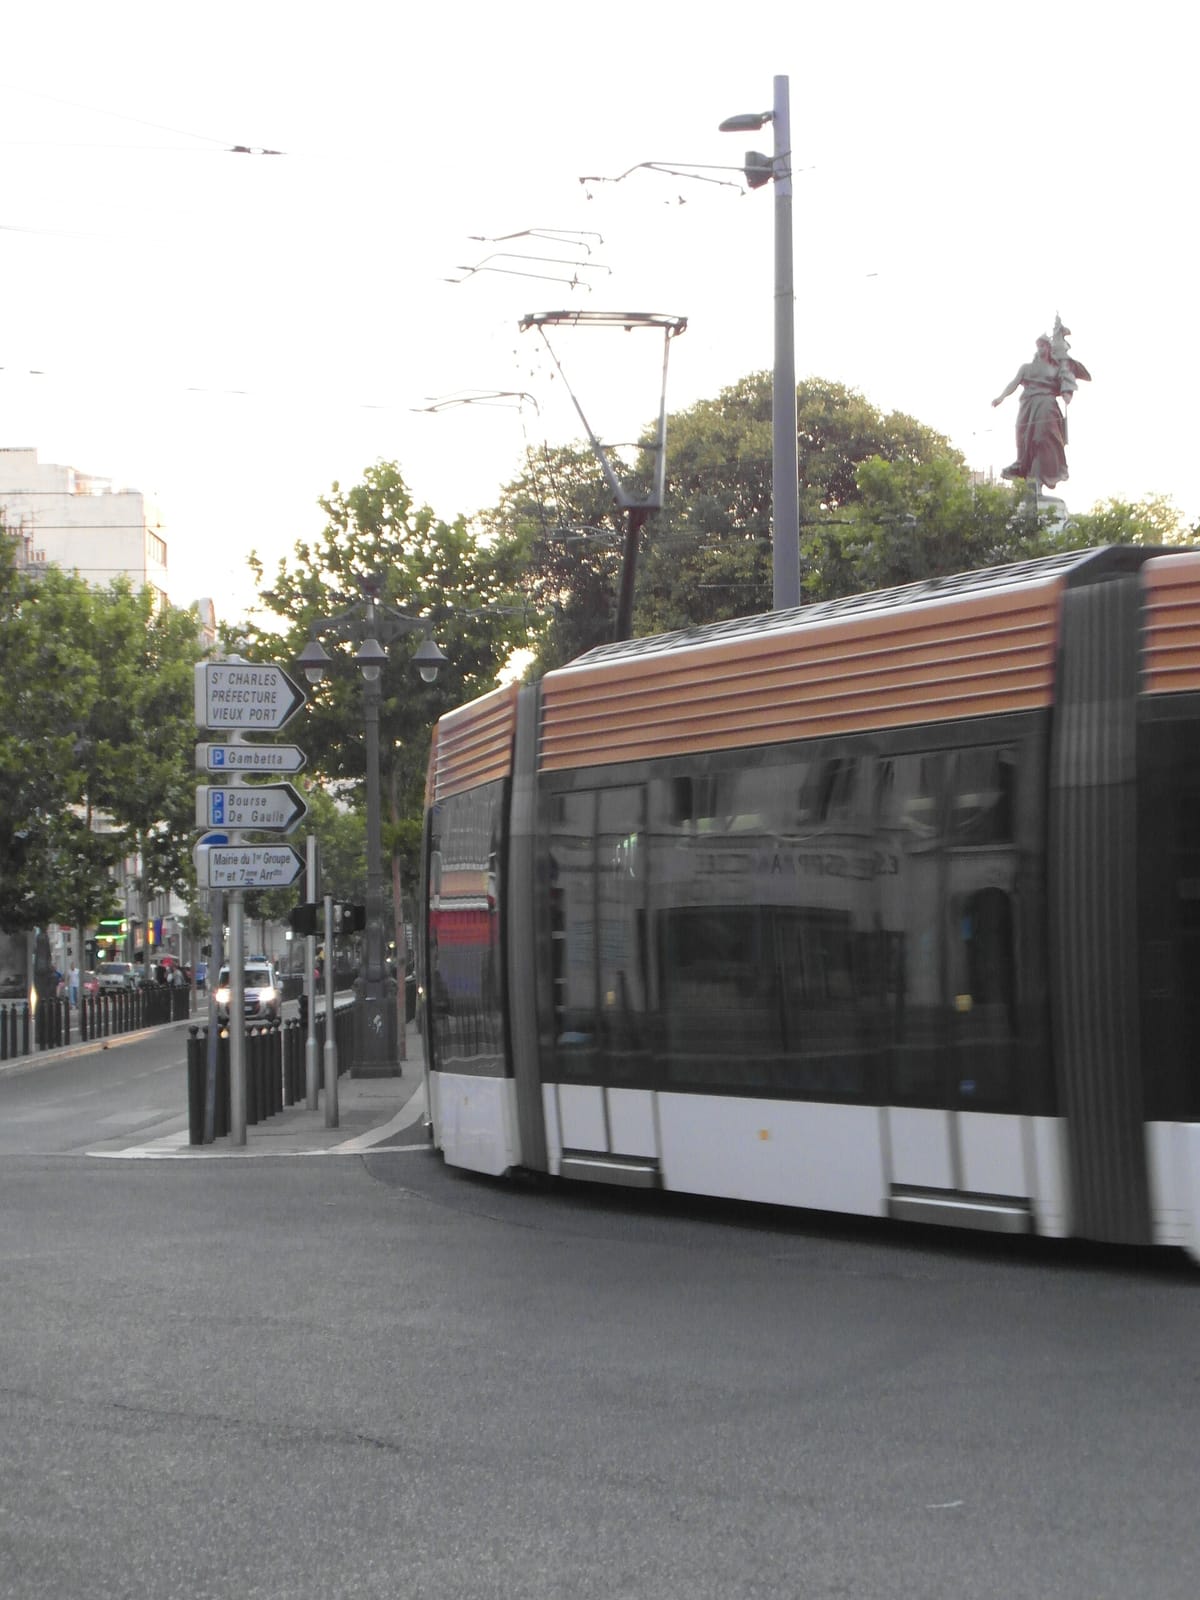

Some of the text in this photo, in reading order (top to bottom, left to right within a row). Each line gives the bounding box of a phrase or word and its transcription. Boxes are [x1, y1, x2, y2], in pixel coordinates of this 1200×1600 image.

[228, 672, 278, 686] CHARLES
[211, 688, 277, 704] PRÉFECTURE
[212, 708, 278, 721] VIEUX PORT
[228, 751, 283, 765] Gambetta
[228, 794, 267, 807] Bourse
[228, 810, 243, 823] De
[251, 810, 285, 823] Gaulle
[213, 853, 238, 865] Mairie
[240, 853, 250, 865] du
[263, 852, 291, 867] Groupe
[227, 871, 236, 881] et
